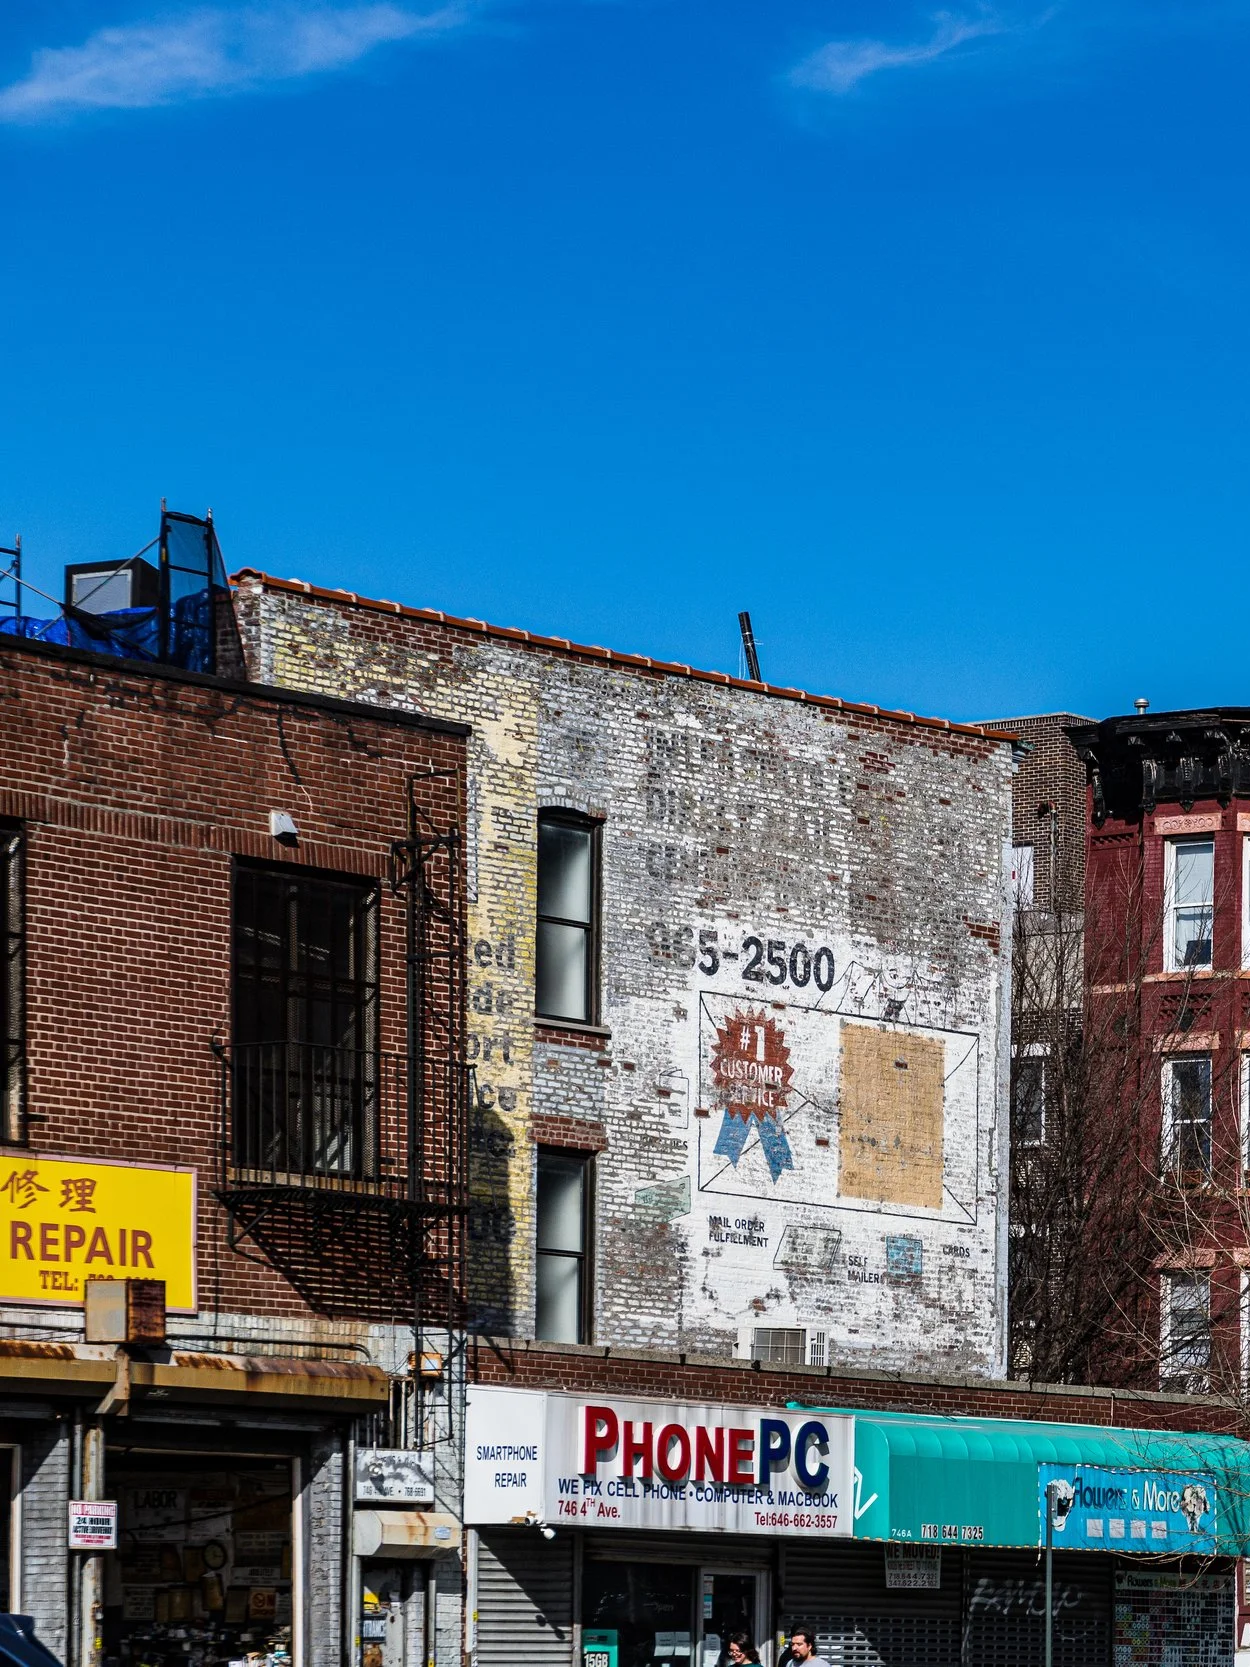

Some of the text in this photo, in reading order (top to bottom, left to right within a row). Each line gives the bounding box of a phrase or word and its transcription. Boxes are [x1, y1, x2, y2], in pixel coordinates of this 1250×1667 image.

[739, 1025, 765, 1062] #1
[720, 1058, 784, 1087] CUSTOMER
[0, 1169, 97, 1213] 修理
[708, 1215, 765, 1232] MAIL ORDER
[10, 1220, 156, 1268] REPAIR
[708, 1232, 769, 1248] FULFILLMENT
[942, 1244, 970, 1258] CARDS
[848, 1255, 868, 1267] SELF
[39, 1270, 79, 1291] TEL:
[476, 1445, 538, 1461] SMARTPHONE
[494, 1473, 527, 1487] REPAIR
[133, 1490, 177, 1508] LABOR
[558, 1478, 838, 1508] WE FIX CELL PHONE COMPUTER & MACBOOK
[1072, 1477, 1181, 1513] Flowers & More
[558, 1500, 577, 1516] 746
[597, 1502, 621, 1518] Ave.
[754, 1512, 838, 1529] Tel:646-662-3557
[891, 1528, 912, 1538] 746A
[922, 1525, 984, 1540] 718 644 7325
[583, 1653, 609, 1667] 15GB
